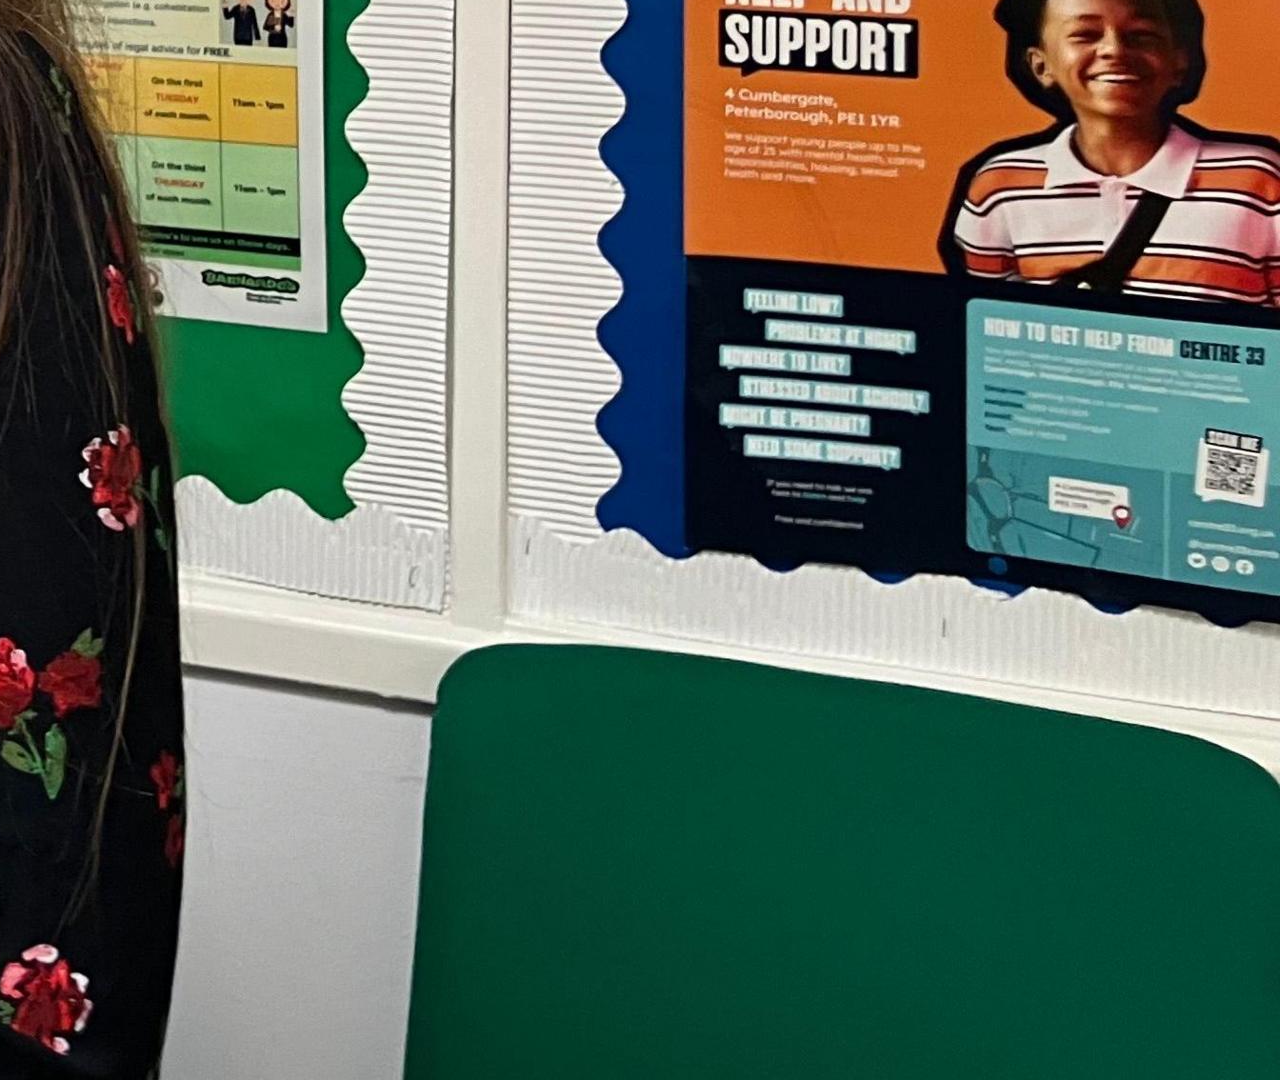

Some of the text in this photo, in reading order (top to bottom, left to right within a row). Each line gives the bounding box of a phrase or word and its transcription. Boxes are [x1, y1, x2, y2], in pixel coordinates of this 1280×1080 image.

[724, 13, 913, 73] SUPPORT
[724, 88, 838, 108] 4 Cumbergate,
[725, 104, 900, 128] Peterborough, PE1 1YR
[984, 317, 1265, 366] HOW TO GET HELP FROM CENTRE 33
